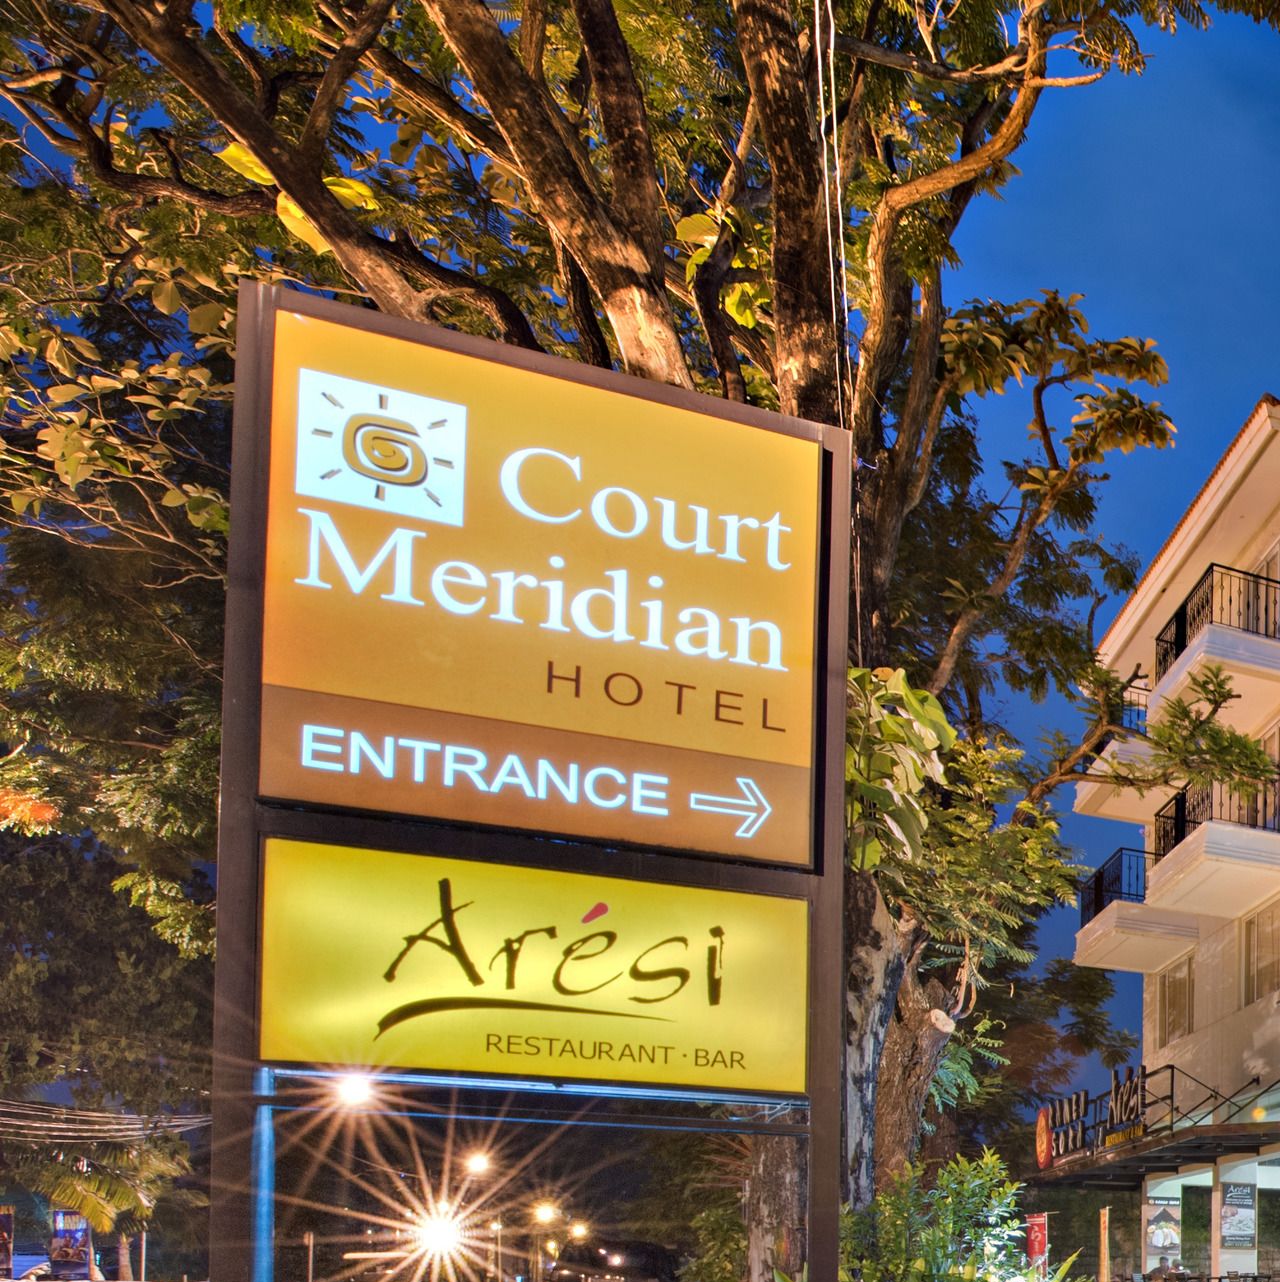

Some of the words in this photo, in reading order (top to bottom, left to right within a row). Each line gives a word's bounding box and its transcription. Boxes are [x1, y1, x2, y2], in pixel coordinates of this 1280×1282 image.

[499, 447, 793, 573] Court
[294, 508, 790, 673] Meridian
[546, 660, 787, 733] HOTEL
[301, 724, 670, 817] ENTRANCE
[383, 878, 725, 1007] Arési
[485, 1033, 675, 1066] RESTAURANT
[693, 1048, 747, 1071] BAR
